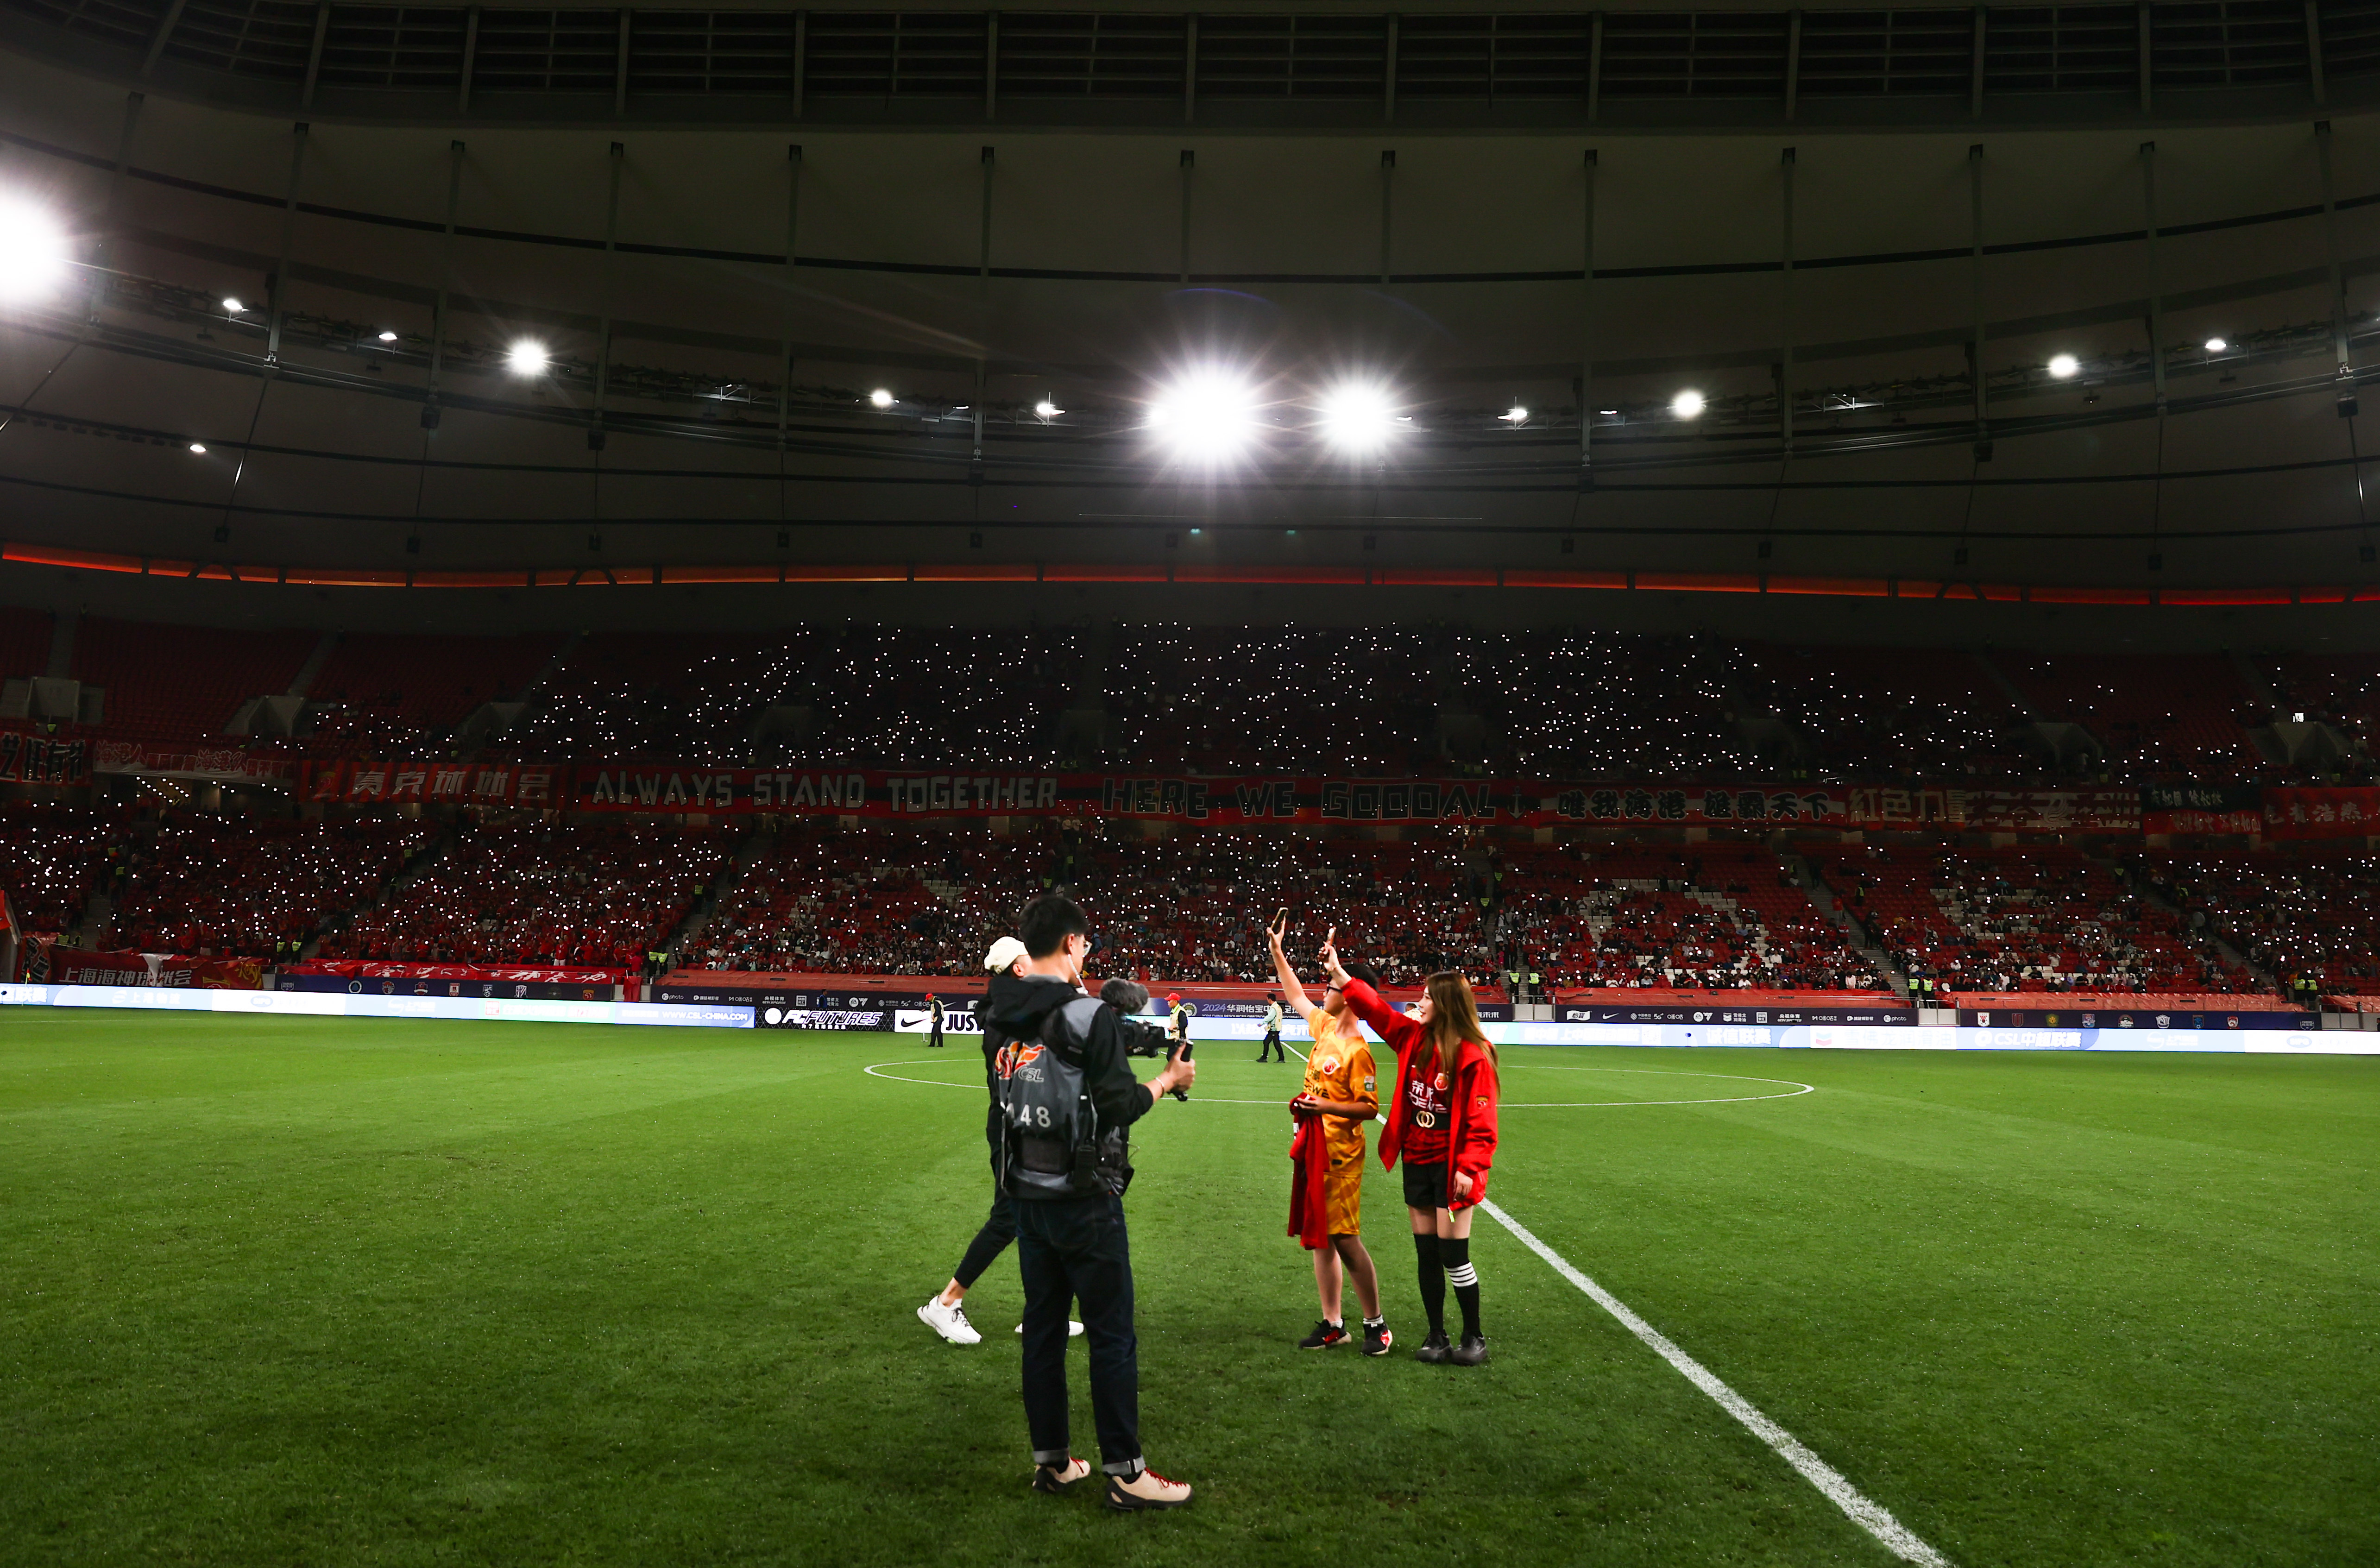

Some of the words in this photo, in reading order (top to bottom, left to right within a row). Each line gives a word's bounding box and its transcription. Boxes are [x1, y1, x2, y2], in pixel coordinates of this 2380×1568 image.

[592, 771, 733, 808] ALWAYS
[753, 774, 865, 808] STAND
[887, 775, 1058, 812] TOGETHER
[1102, 778, 1208, 819] HERE
[1236, 781, 1297, 817] WE
[1321, 782, 1495, 820] GOOOAL
[1557, 789, 1691, 821] 唯我海港
[1703, 791, 1829, 821] 雄霸天下
[662, 1011, 748, 1021] WWW.CSL-CHINA.COM
[1202, 1004, 1226, 1013] 2024
[946, 1014, 982, 1031] JUS
[1018, 1067, 1044, 1083] CSL
